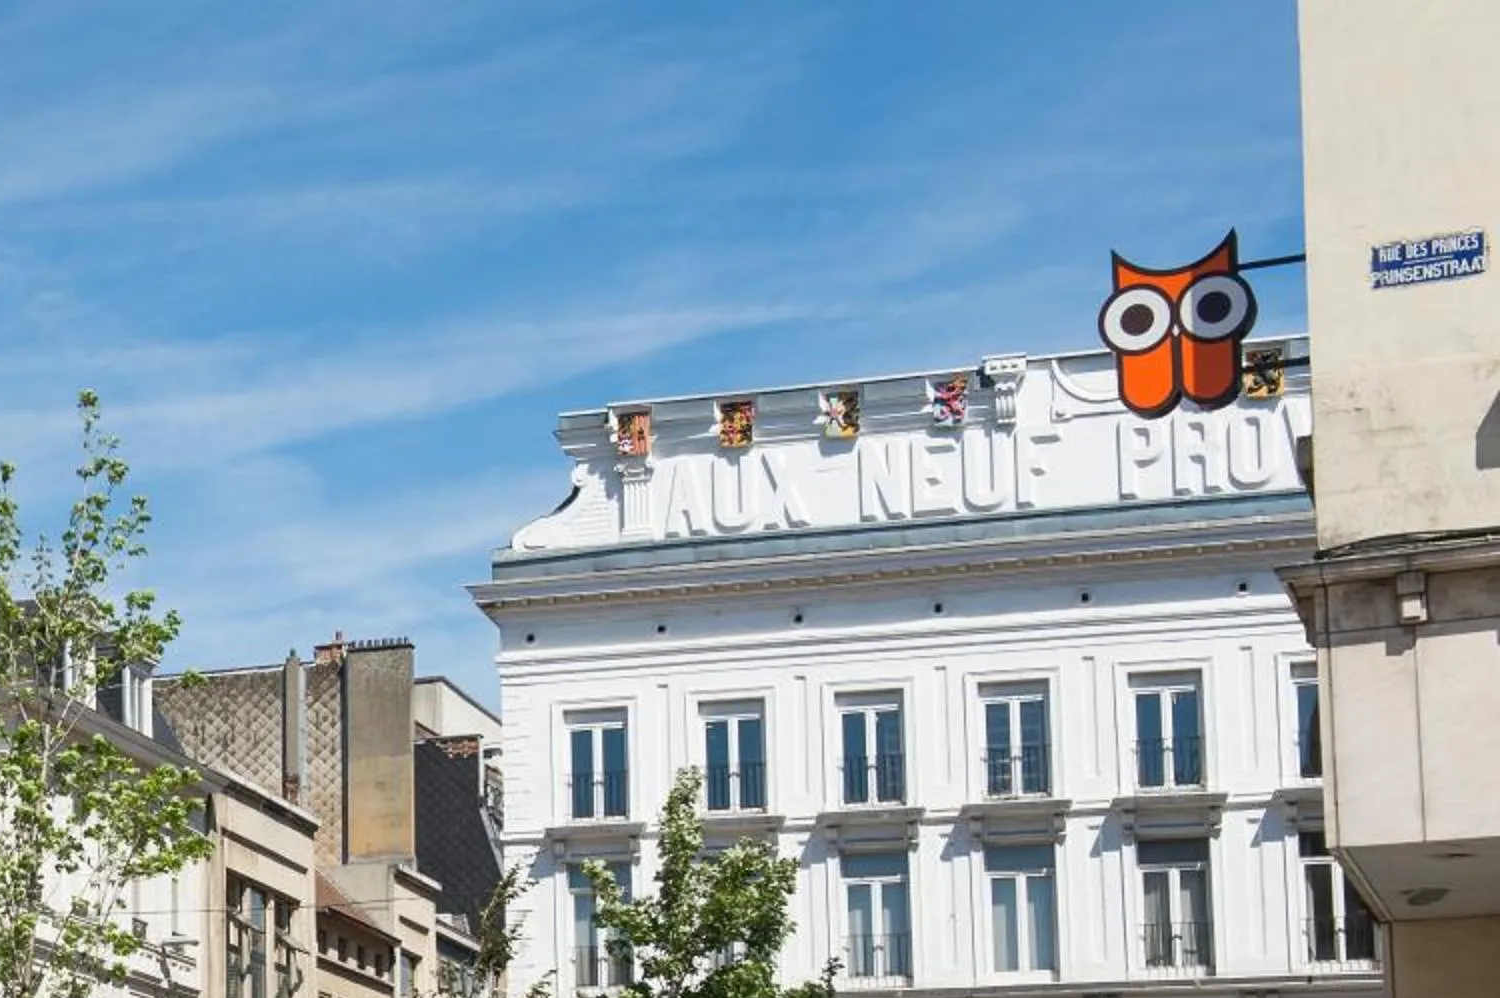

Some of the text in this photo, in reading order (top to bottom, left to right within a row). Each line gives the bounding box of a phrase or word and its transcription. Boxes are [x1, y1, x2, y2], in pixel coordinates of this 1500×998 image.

[1379, 233, 1479, 263] RUE DES PRINCES
[1370, 255, 1485, 286] PRINSENSTRAAT
[661, 447, 813, 538] AUX
[855, 430, 1063, 523] NEUF
